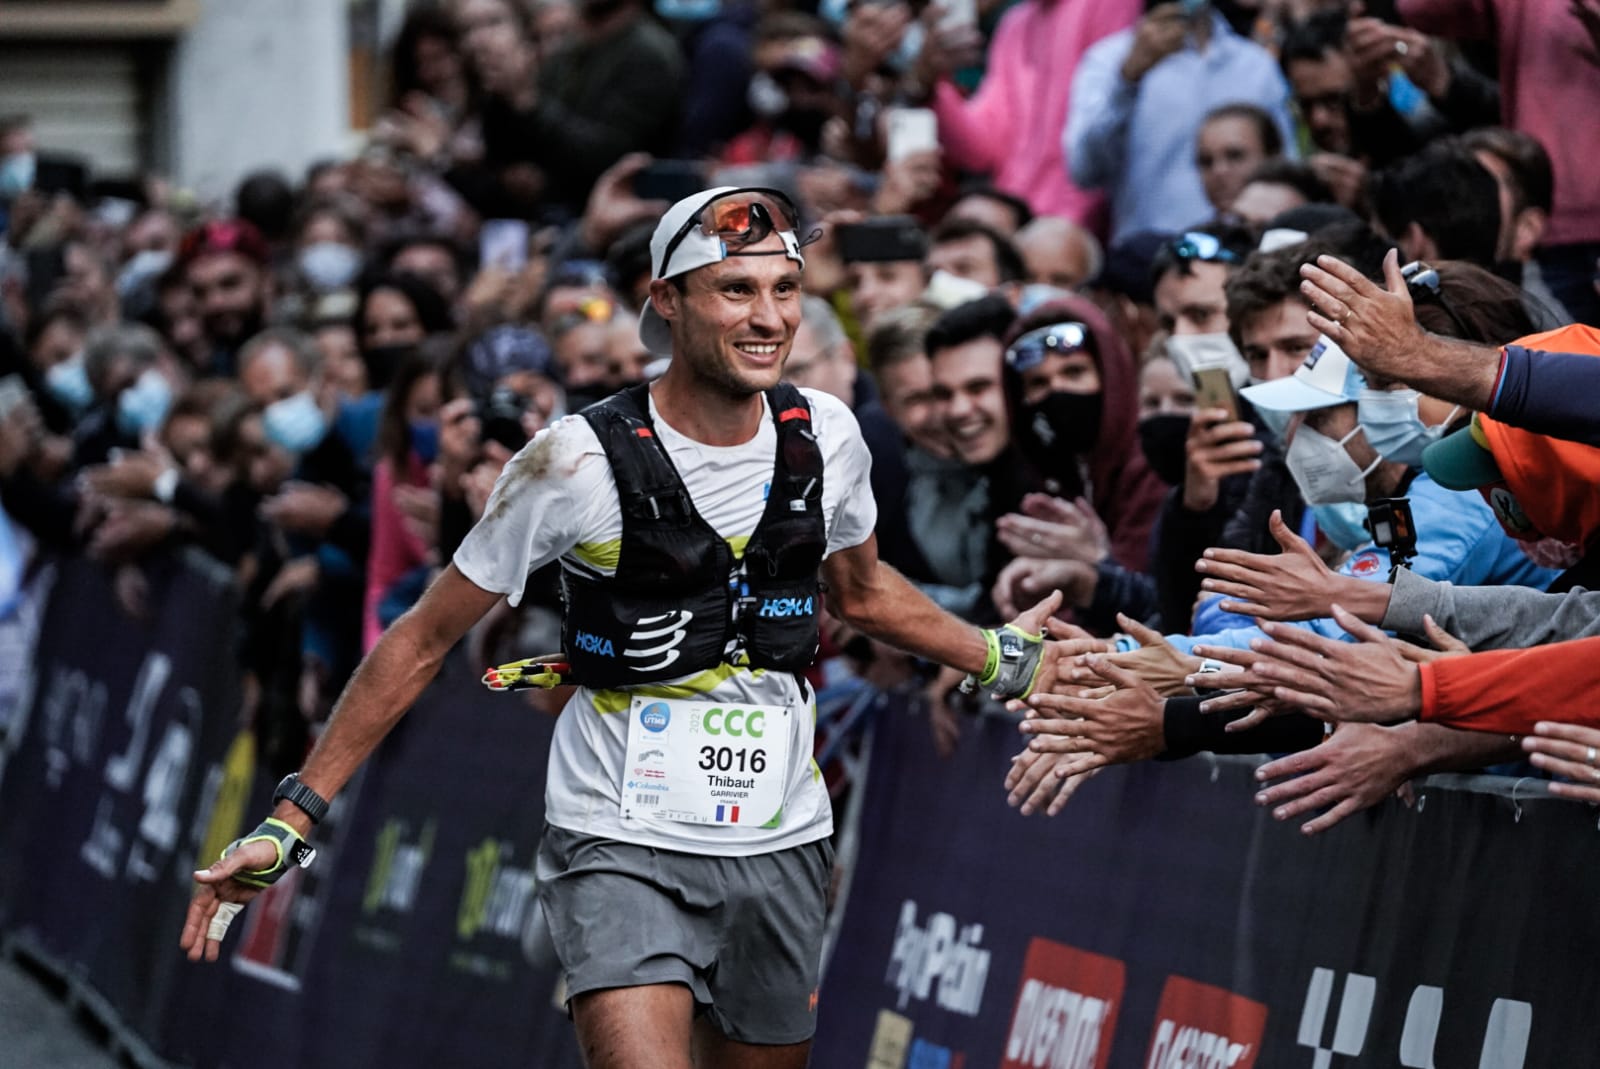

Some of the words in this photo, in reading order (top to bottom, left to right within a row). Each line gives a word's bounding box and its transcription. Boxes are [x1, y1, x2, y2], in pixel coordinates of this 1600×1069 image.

[760, 596, 813, 617] HOKA
[575, 630, 615, 657] HOKA
[703, 708, 764, 738] CCC
[698, 746, 766, 773] 3016
[707, 775, 755, 789] Thibaut
